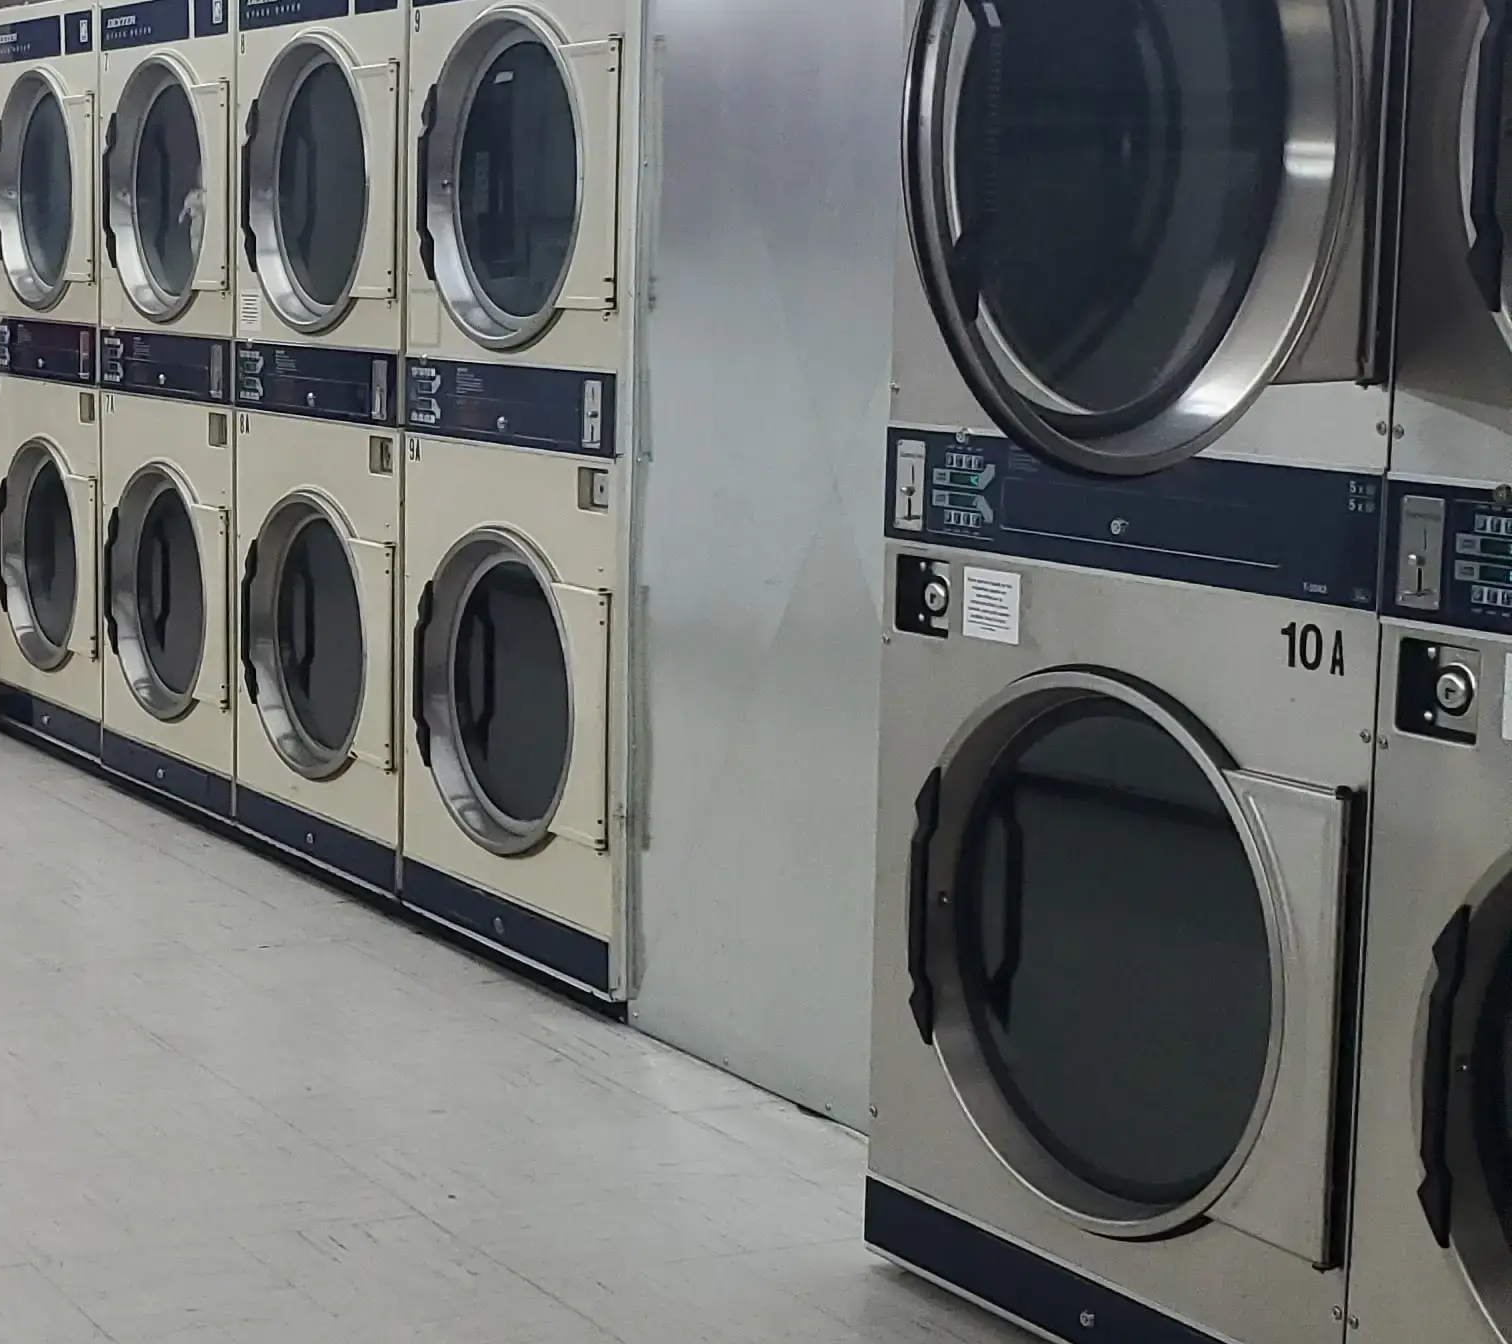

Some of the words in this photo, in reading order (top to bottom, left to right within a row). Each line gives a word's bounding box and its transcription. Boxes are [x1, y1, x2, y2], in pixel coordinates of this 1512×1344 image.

[106, 15, 137, 29] DEXTER
[414, 9, 421, 33] 9
[239, 413, 250, 435] 8A
[408, 438, 421, 462] 9A
[1281, 621, 1323, 671] 10
[1329, 629, 1345, 677] A
